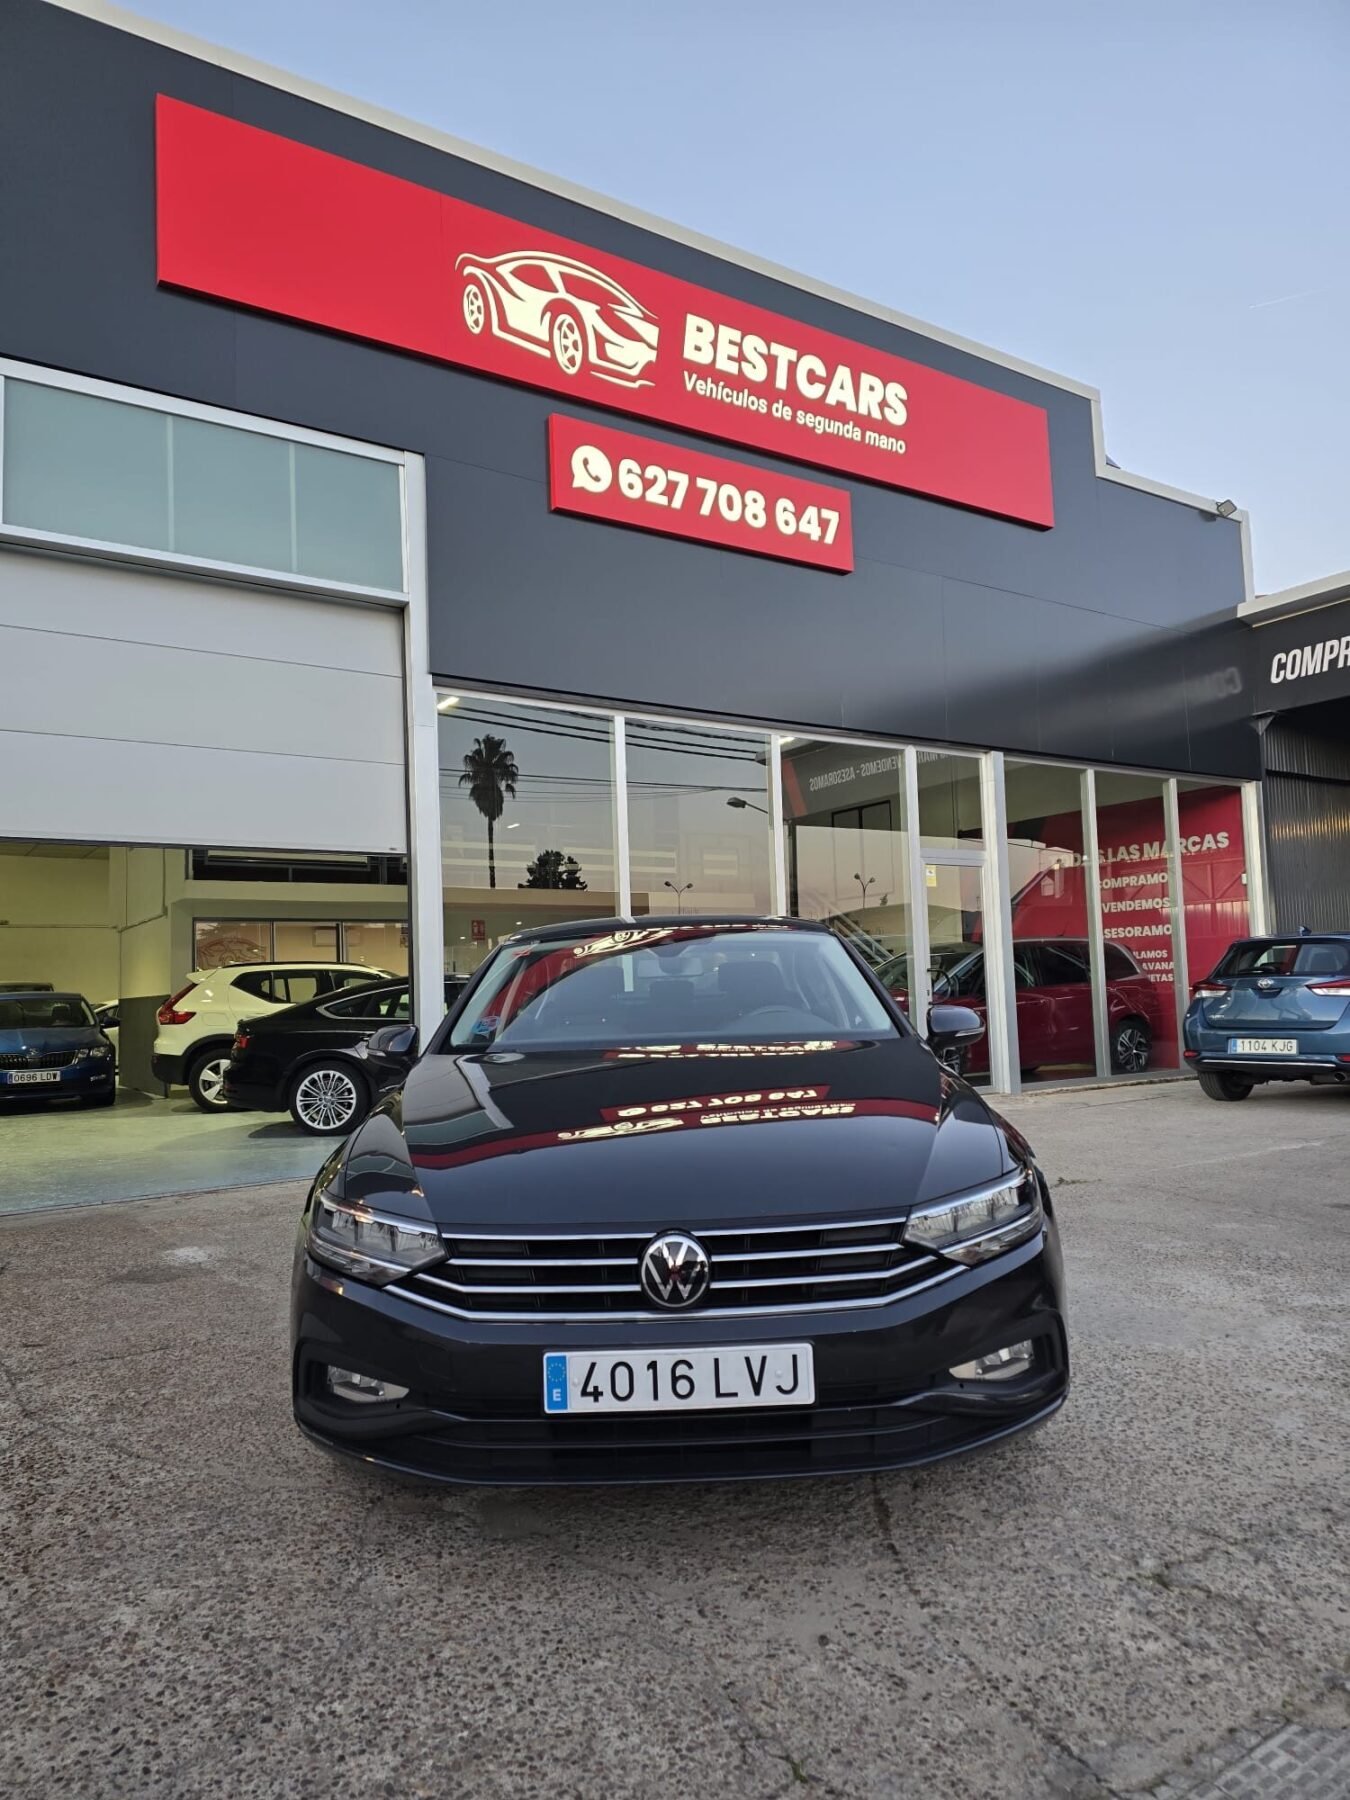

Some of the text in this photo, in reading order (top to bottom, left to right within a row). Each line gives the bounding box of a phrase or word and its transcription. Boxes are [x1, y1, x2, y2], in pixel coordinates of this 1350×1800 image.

[682, 313, 908, 426] BESTCARS
[683, 370, 907, 454] Vehículos de segunda mano
[618, 458, 840, 545] 627 708 647
[1270, 635, 1350, 684] COMPR
[1108, 843, 1141, 863] LAS
[1102, 897, 1170, 913] VENDEMOS
[1241, 1040, 1293, 1052] 1104 KJG
[553, 1354, 799, 1402] E 4016 LVJ
